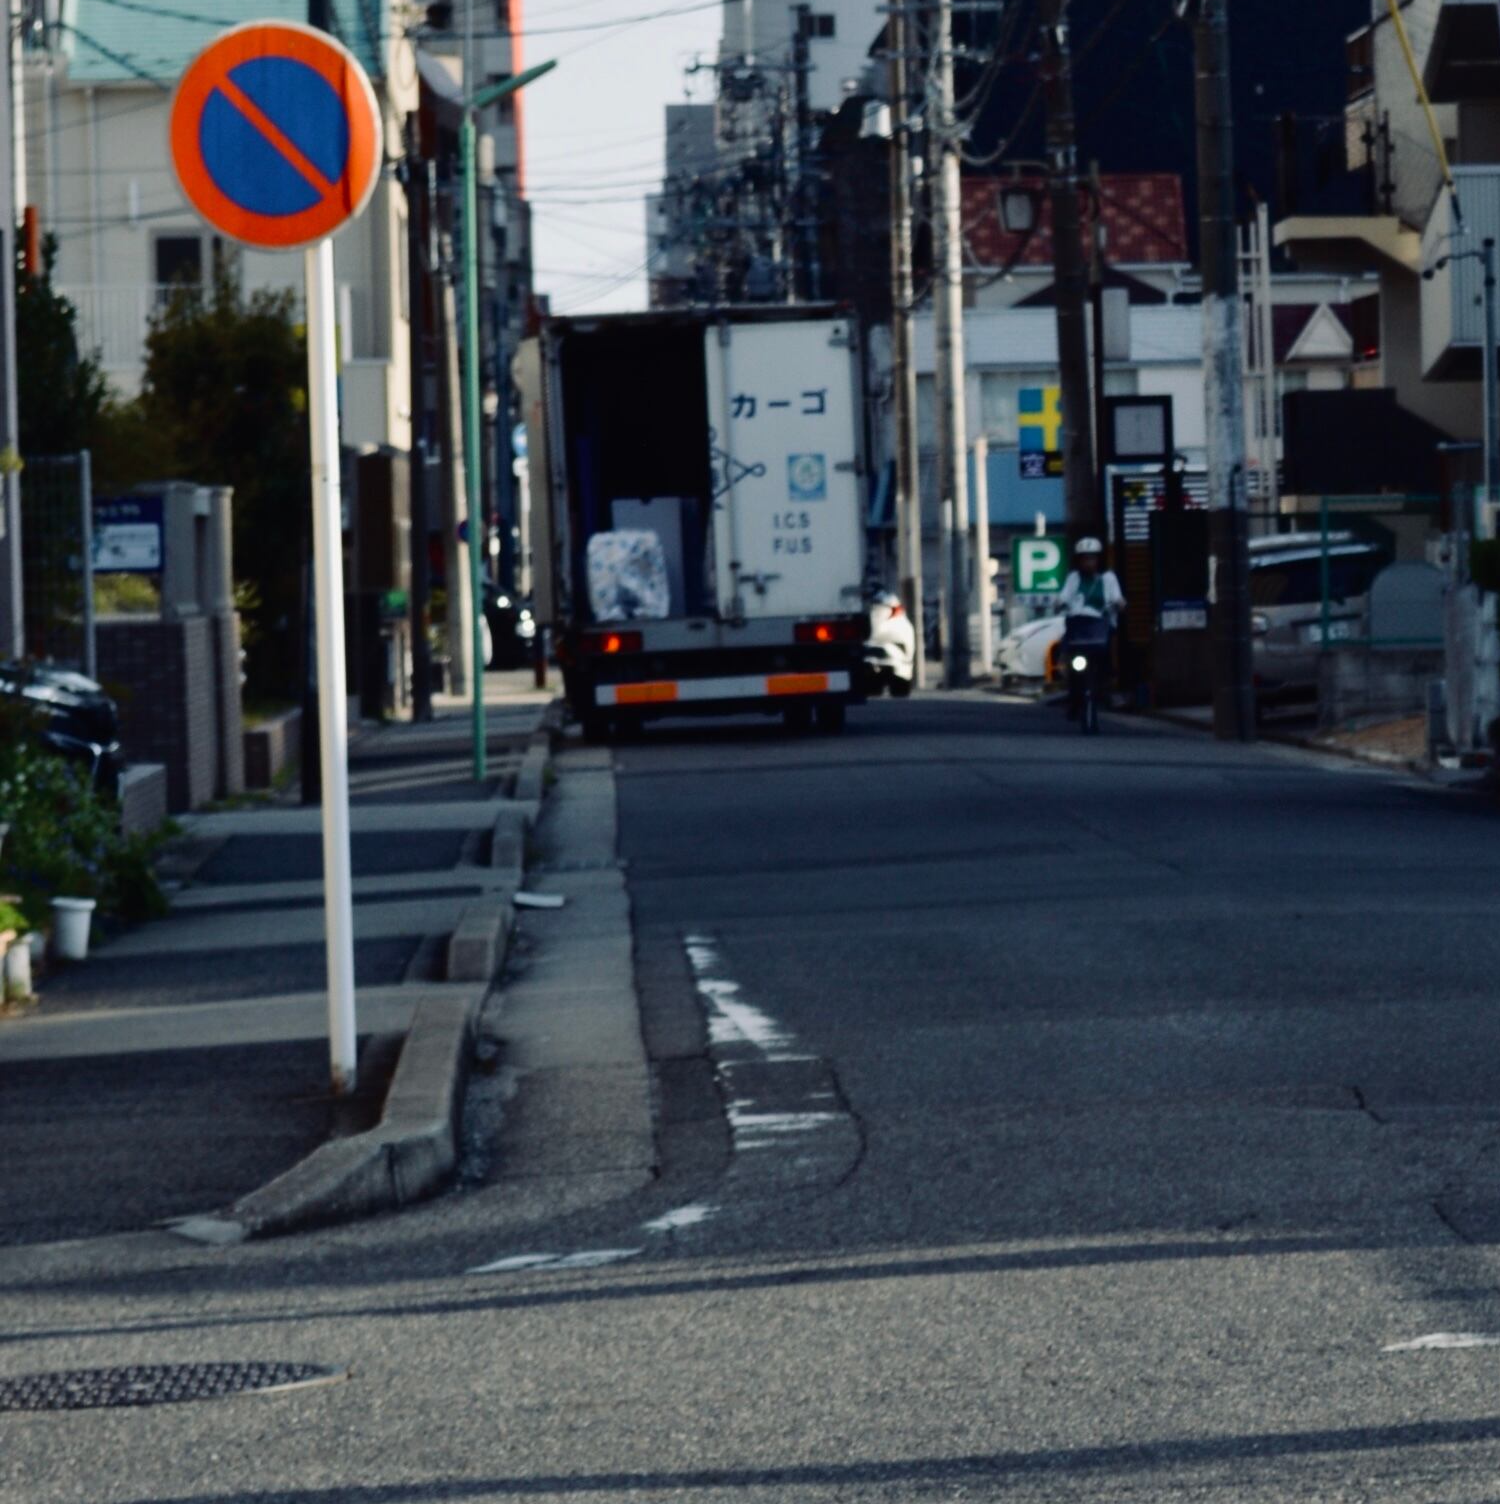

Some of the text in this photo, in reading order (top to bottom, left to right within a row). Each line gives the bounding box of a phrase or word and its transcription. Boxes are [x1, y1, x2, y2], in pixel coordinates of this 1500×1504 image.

[732, 388, 828, 419] カーゴ
[1017, 538, 1062, 591] P
